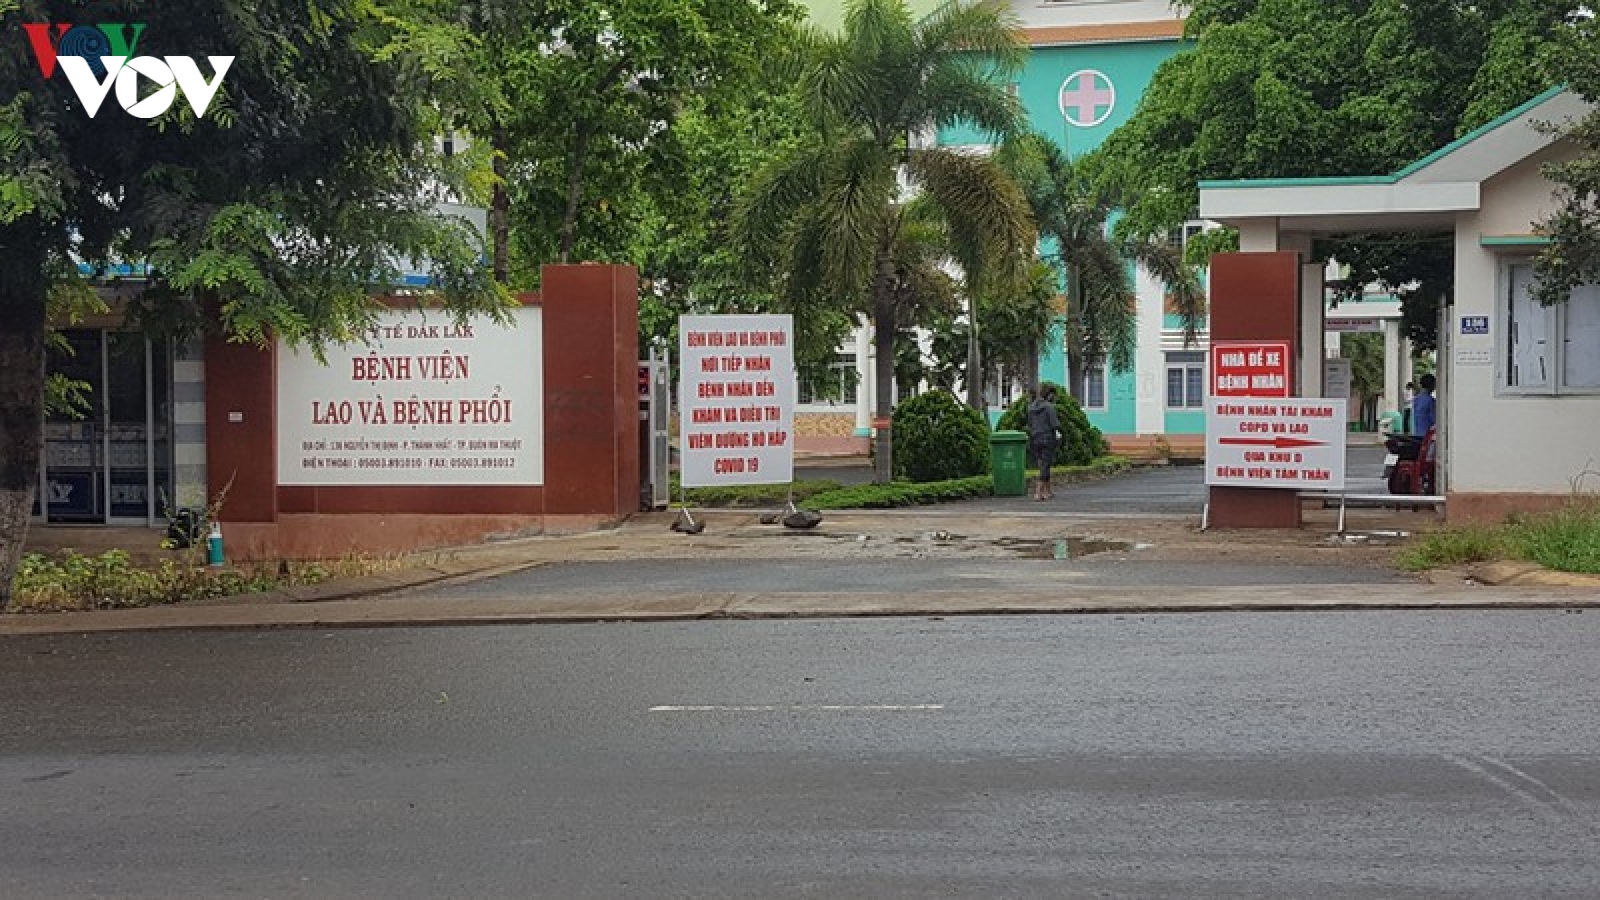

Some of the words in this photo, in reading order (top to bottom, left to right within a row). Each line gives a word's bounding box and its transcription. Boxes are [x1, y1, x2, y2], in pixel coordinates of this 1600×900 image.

[688, 329, 706, 347] BỆNH
[708, 329, 723, 347] VIỆN
[726, 331, 736, 346] LAO
[740, 330, 749, 346] VÀ
[750, 329, 768, 347] BỆNH
[769, 327, 786, 346] PHỔI
[701, 356, 719, 372] NƠI
[722, 352, 742, 372] TIẾP
[744, 354, 771, 374] NHẬN
[1221, 350, 1245, 367] NHÀ
[1248, 348, 1264, 367] ĐỂ
[1265, 351, 1281, 367] XE
[352, 350, 411, 386] BỆNH
[417, 350, 469, 385] VIỆN
[699, 380, 725, 398] BỆNH
[727, 379, 753, 397] NHÂN
[756, 378, 775, 397] ĐẾN
[1217, 374, 1249, 391] BỆNH
[1251, 373, 1283, 389] NHÂN
[312, 401, 353, 425] LAO
[358, 394, 388, 425] VÀ
[393, 394, 452, 430] BỆNH
[459, 384, 512, 425] PHỔI
[692, 406, 722, 424] KHÁM
[724, 406, 738, 422] VÀ
[740, 404, 762, 422] ĐIỀU
[764, 405, 781, 422] TRỊ
[1217, 403, 1245, 417] BỆNH
[1248, 403, 1277, 417] NHÂN
[1280, 405, 1297, 417] TÁI
[1301, 405, 1333, 418] KHÁM
[1239, 422, 1269, 433] COPD
[1271, 422, 1287, 433] VÀ
[1289, 423, 1309, 434] LAO
[688, 431, 713, 449] VIÊM
[716, 431, 750, 448] ĐƯỜNG
[752, 430, 766, 447] HÔ
[768, 428, 787, 447] HẤP
[714, 457, 744, 474] COVID
[747, 457, 759, 473] 19
[1243, 451, 1265, 463] QUA
[1268, 452, 1291, 462] KHU
[1294, 453, 1303, 462] D
[1216, 466, 1245, 478] BỆNH
[1247, 466, 1273, 480] VIỆN
[1275, 467, 1299, 479] TÂM
[1301, 467, 1331, 481] THẦN
